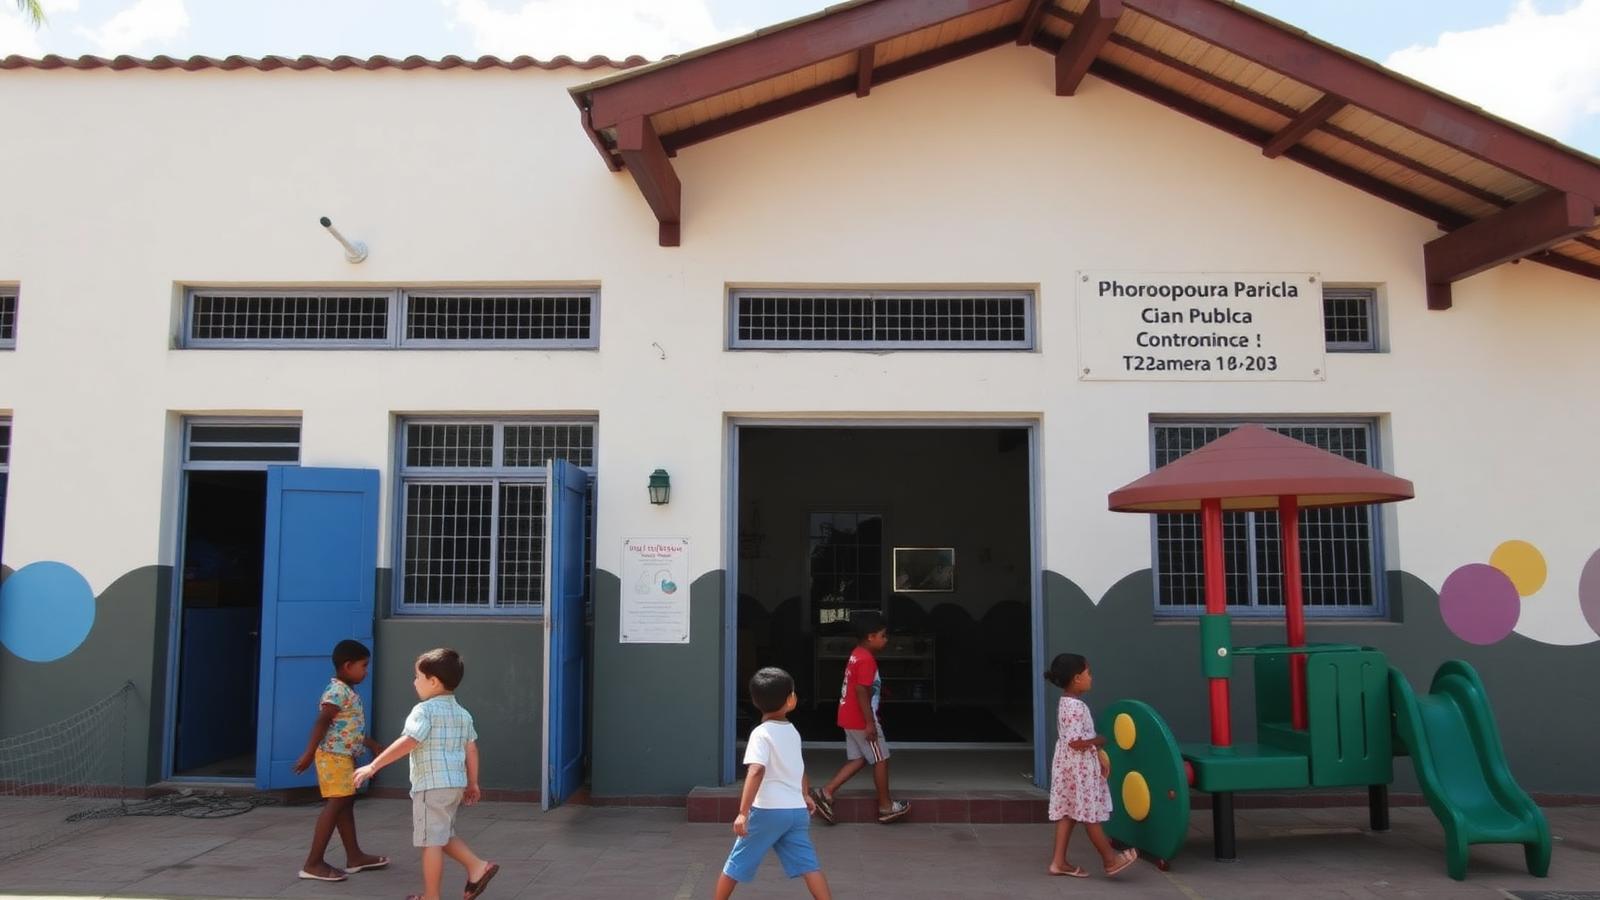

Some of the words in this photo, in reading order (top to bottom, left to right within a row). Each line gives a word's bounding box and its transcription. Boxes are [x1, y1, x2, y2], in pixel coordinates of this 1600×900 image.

[1098, 280, 1229, 301] Phoroopoura
[1234, 281, 1299, 297] Paricla
[1141, 308, 1184, 324] Cian
[1189, 308, 1253, 324] Publca
[1136, 332, 1250, 348] Contronince
